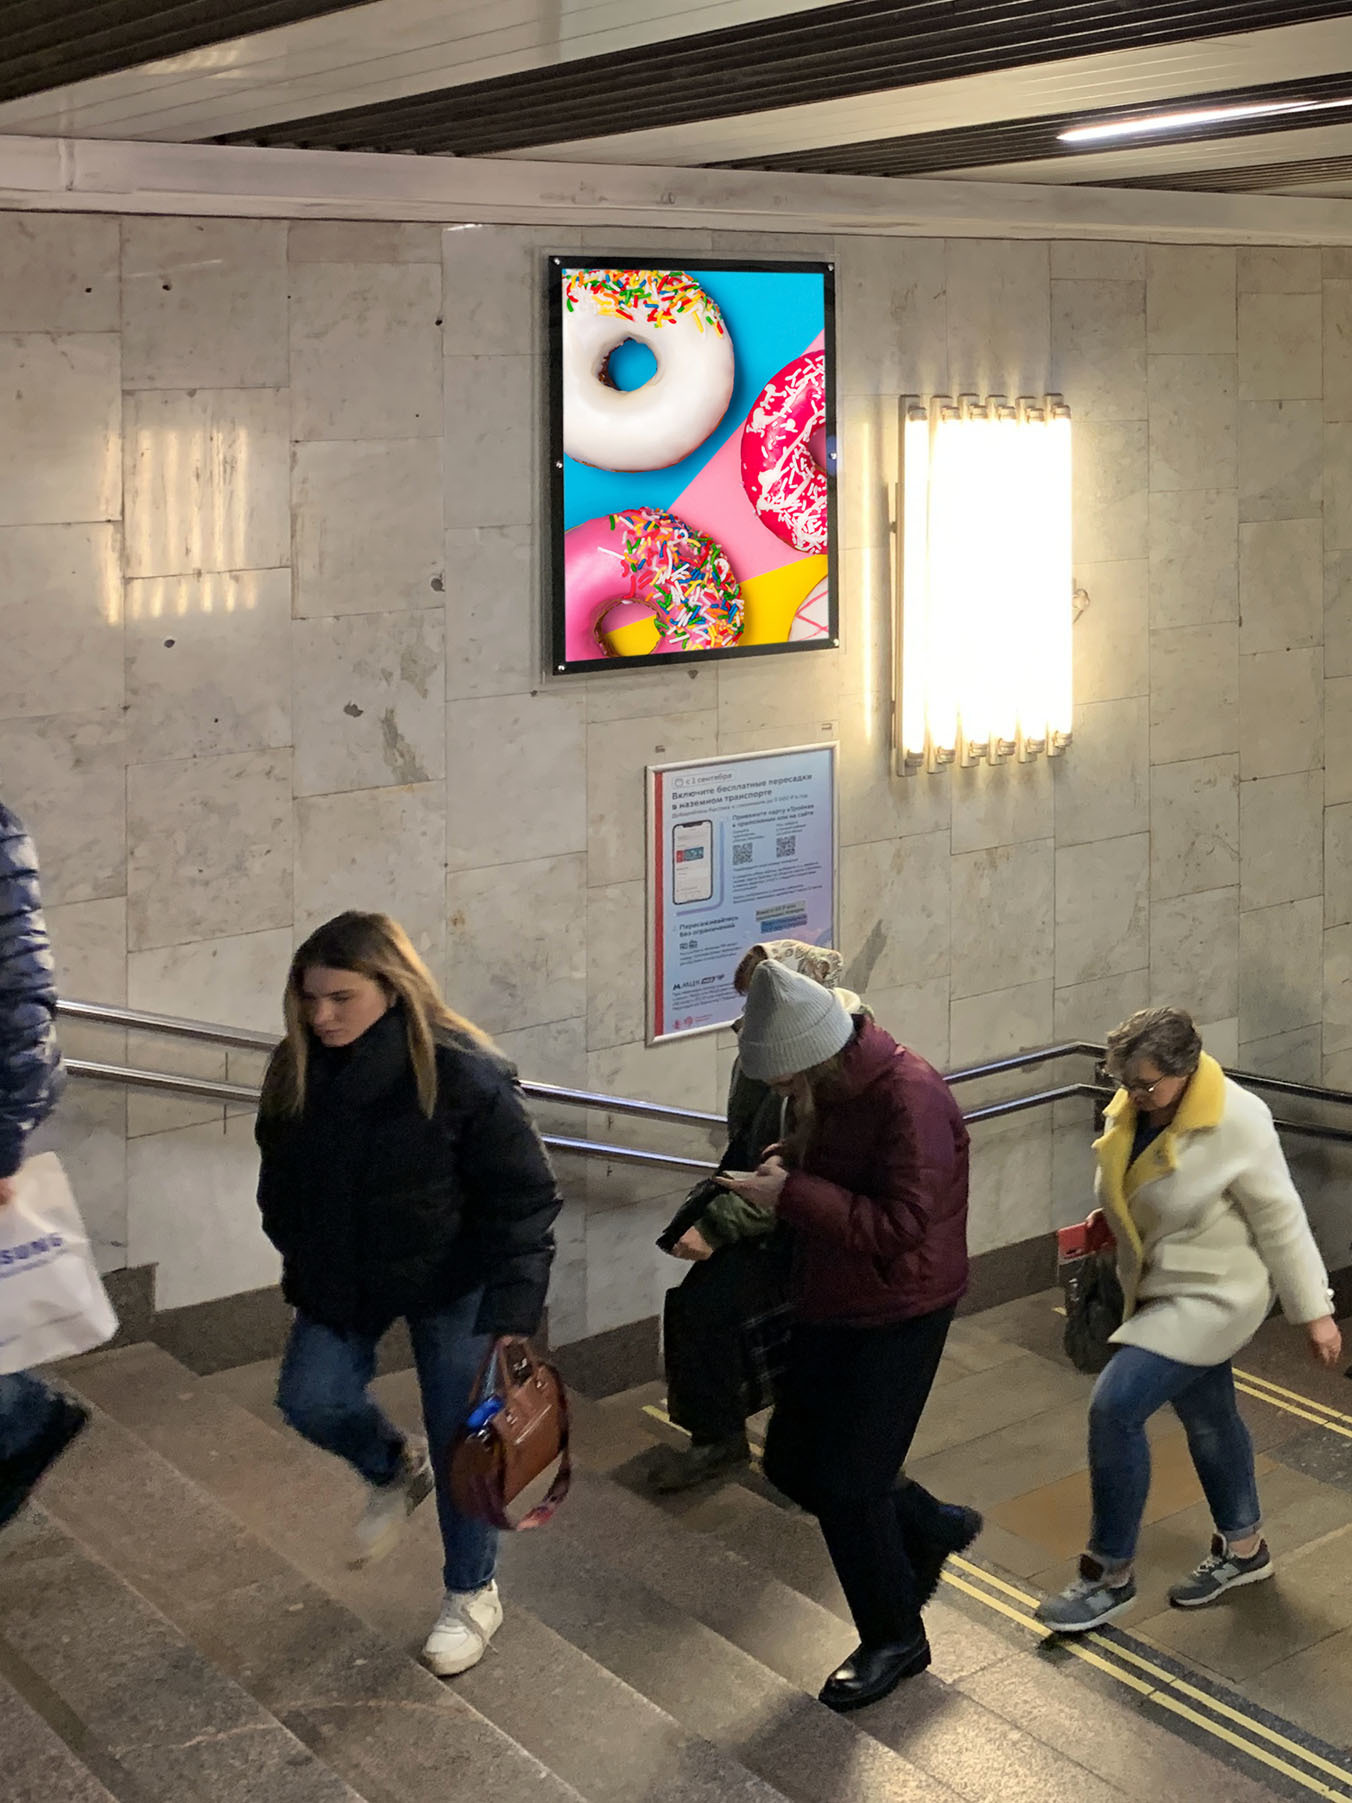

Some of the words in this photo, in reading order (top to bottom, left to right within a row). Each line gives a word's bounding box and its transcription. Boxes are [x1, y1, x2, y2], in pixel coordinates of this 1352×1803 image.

[672, 787, 715, 800] Включите
[716, 779, 767, 794] бесплатные
[768, 774, 812, 786] пересадки
[679, 796, 723, 809] наземном
[724, 788, 773, 802] транспорте
